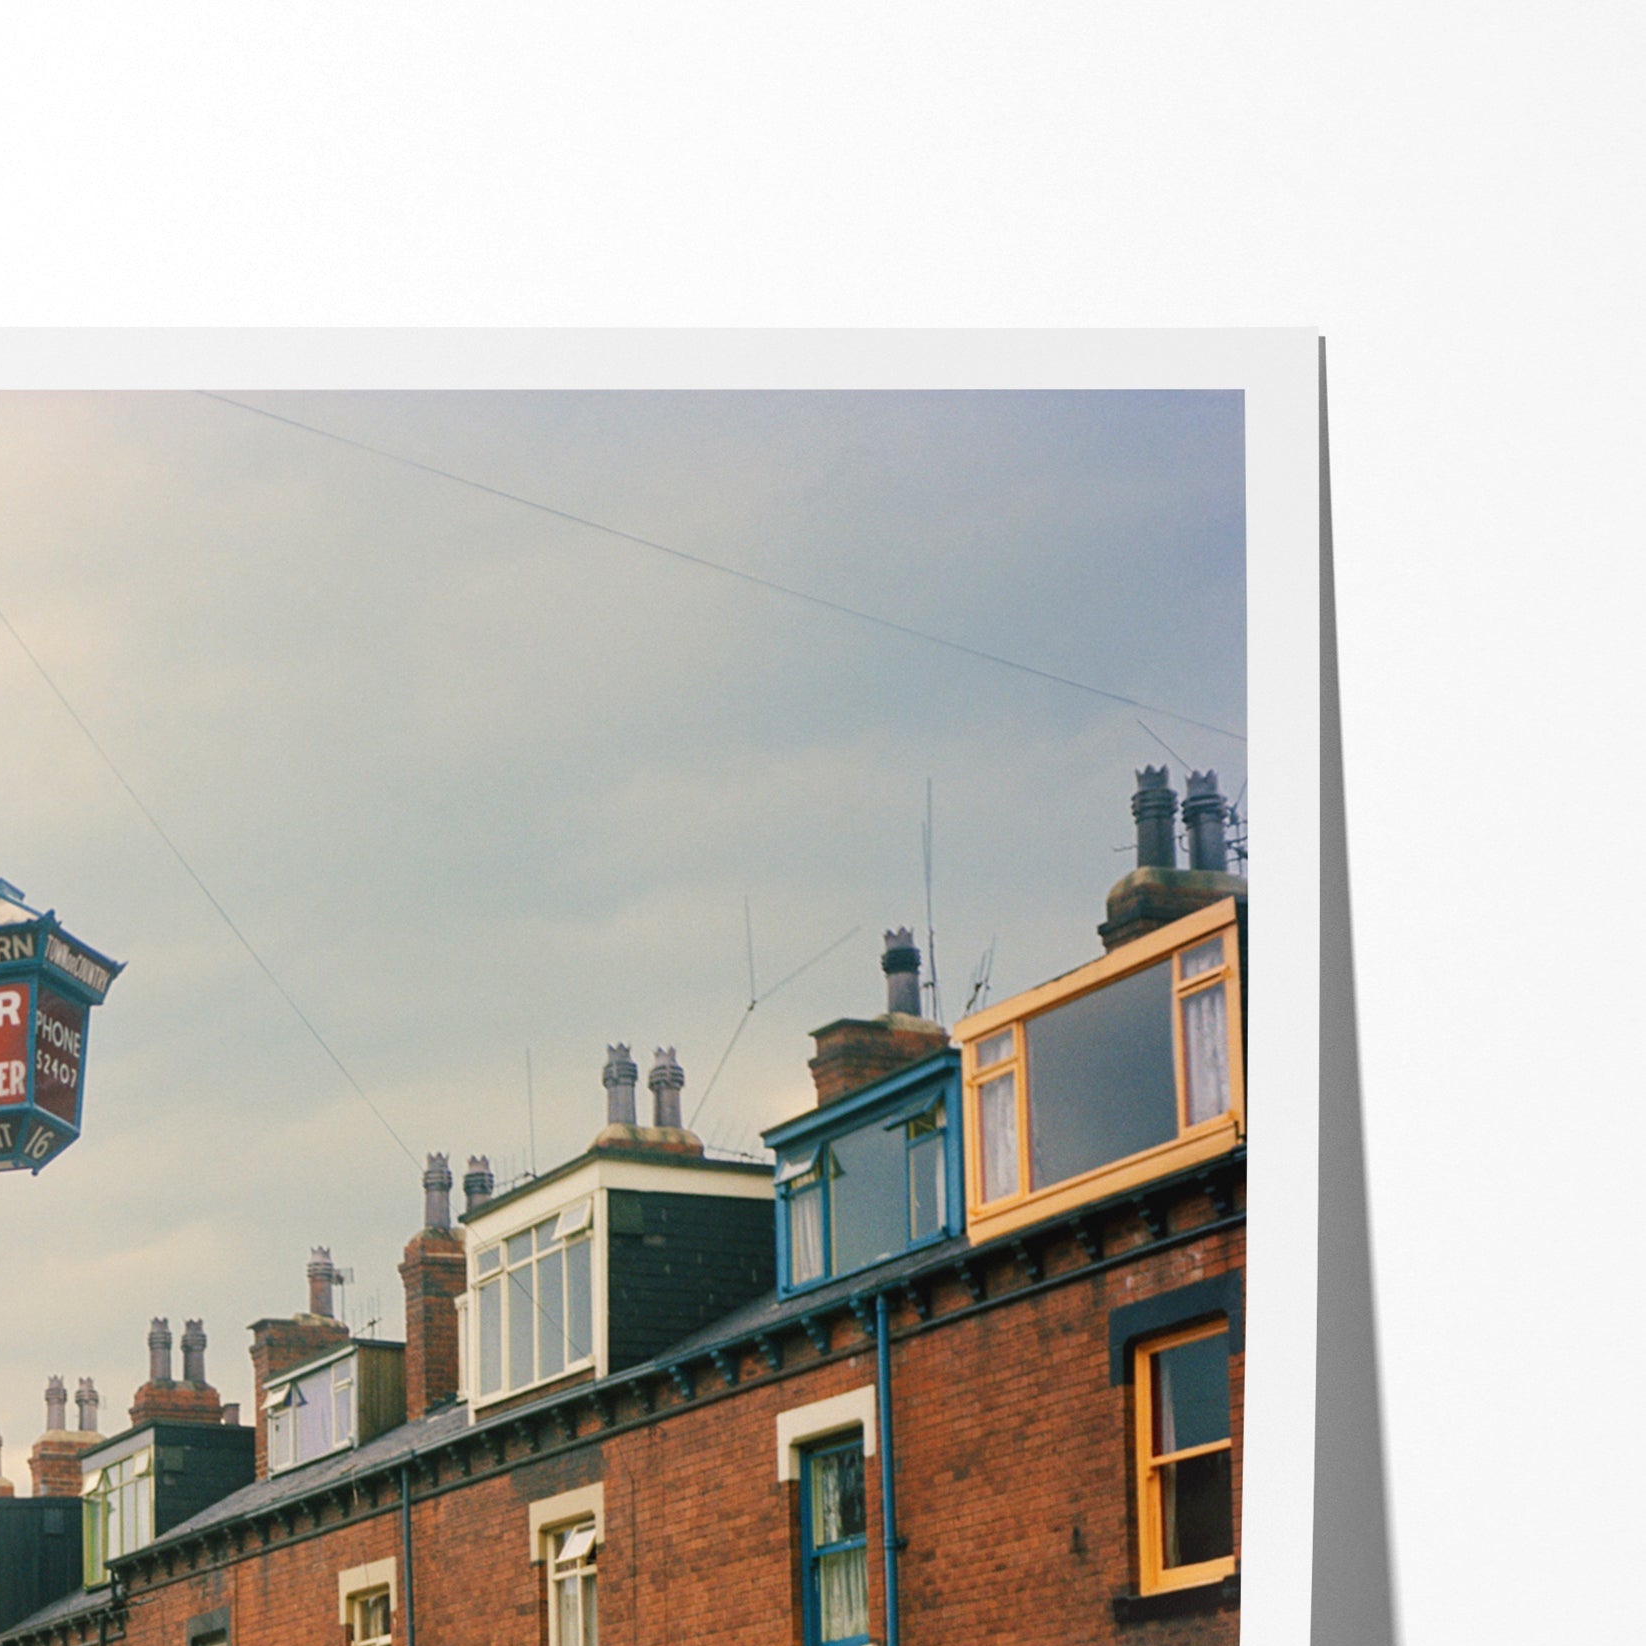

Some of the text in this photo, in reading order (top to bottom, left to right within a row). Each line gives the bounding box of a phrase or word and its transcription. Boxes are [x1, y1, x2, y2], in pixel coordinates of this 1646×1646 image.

[35, 1009, 80, 1058] PHONE
[36, 1049, 78, 1089] 52407
[24, 1126, 55, 1159] 16
